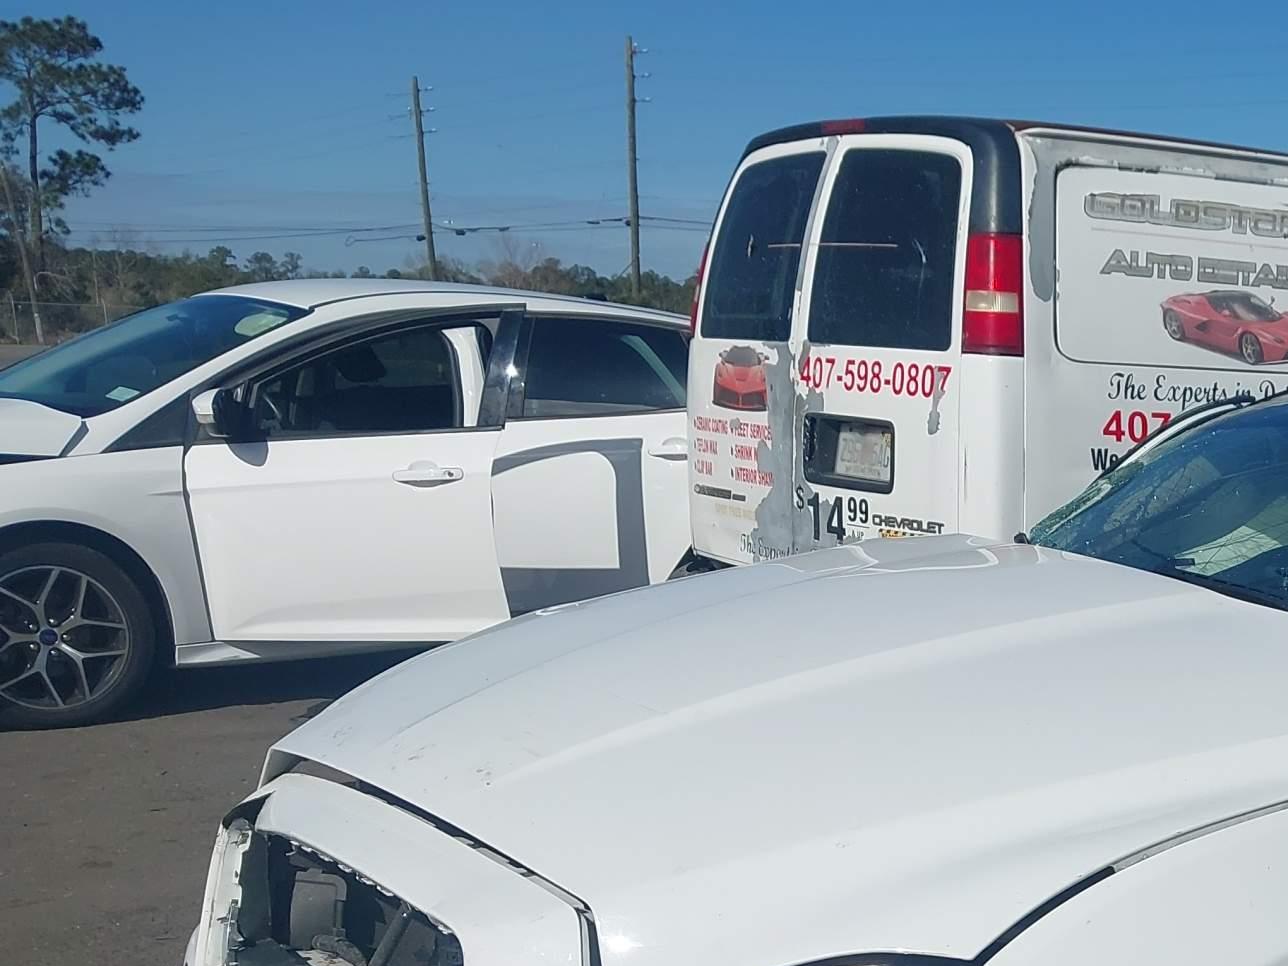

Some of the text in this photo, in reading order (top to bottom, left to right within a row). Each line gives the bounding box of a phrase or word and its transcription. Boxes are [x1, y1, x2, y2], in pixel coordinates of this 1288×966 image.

[1099, 248, 1194, 281] AUTO
[800, 355, 953, 399] 407-598-0807
[1108, 372, 1147, 401] The
[1153, 374, 1228, 411] Experts
[872, 513, 945, 535] CHEVROLET
